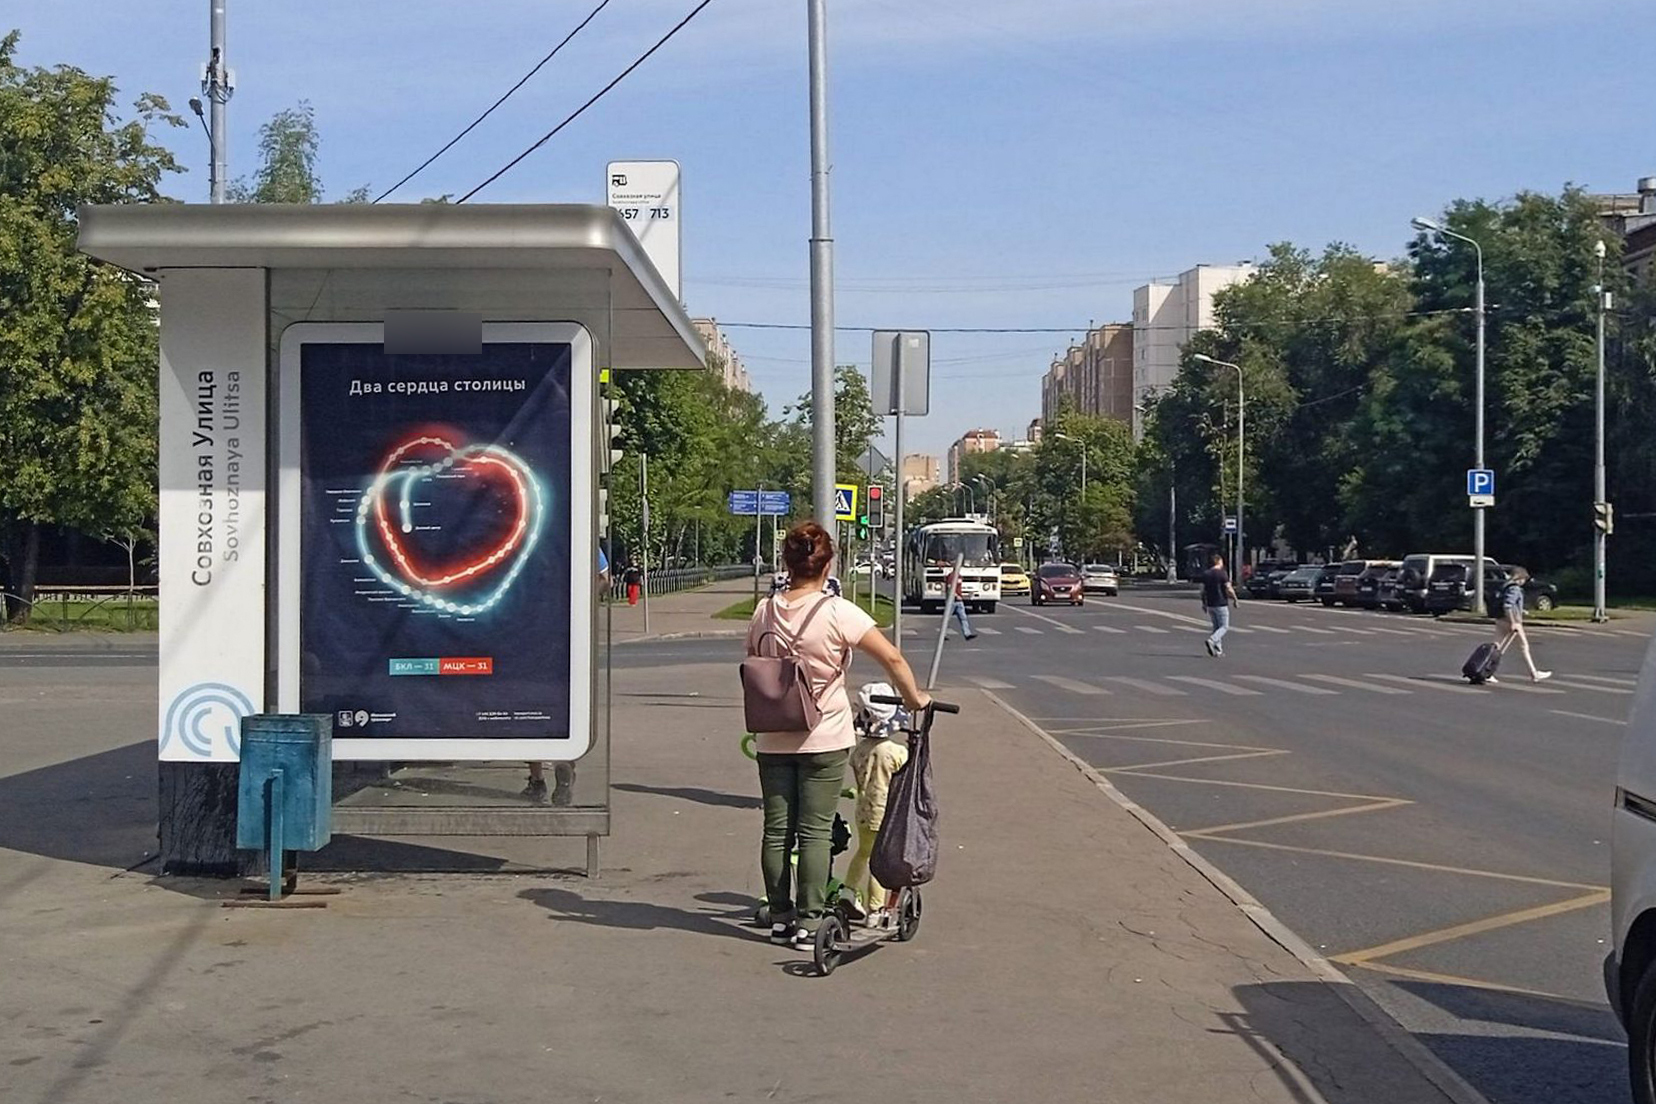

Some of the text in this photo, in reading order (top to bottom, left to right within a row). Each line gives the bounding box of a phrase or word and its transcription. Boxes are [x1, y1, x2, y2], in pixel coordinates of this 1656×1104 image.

[650, 208, 669, 219] 713
[349, 379, 526, 396] Два сердца столицы
[223, 371, 243, 562] Sovhoznaya Ulitsa
[192, 370, 217, 586] Совхозная Улица
[1475, 473, 1489, 493] P
[443, 662, 465, 671] МЦК
[477, 662, 488, 670] 31
